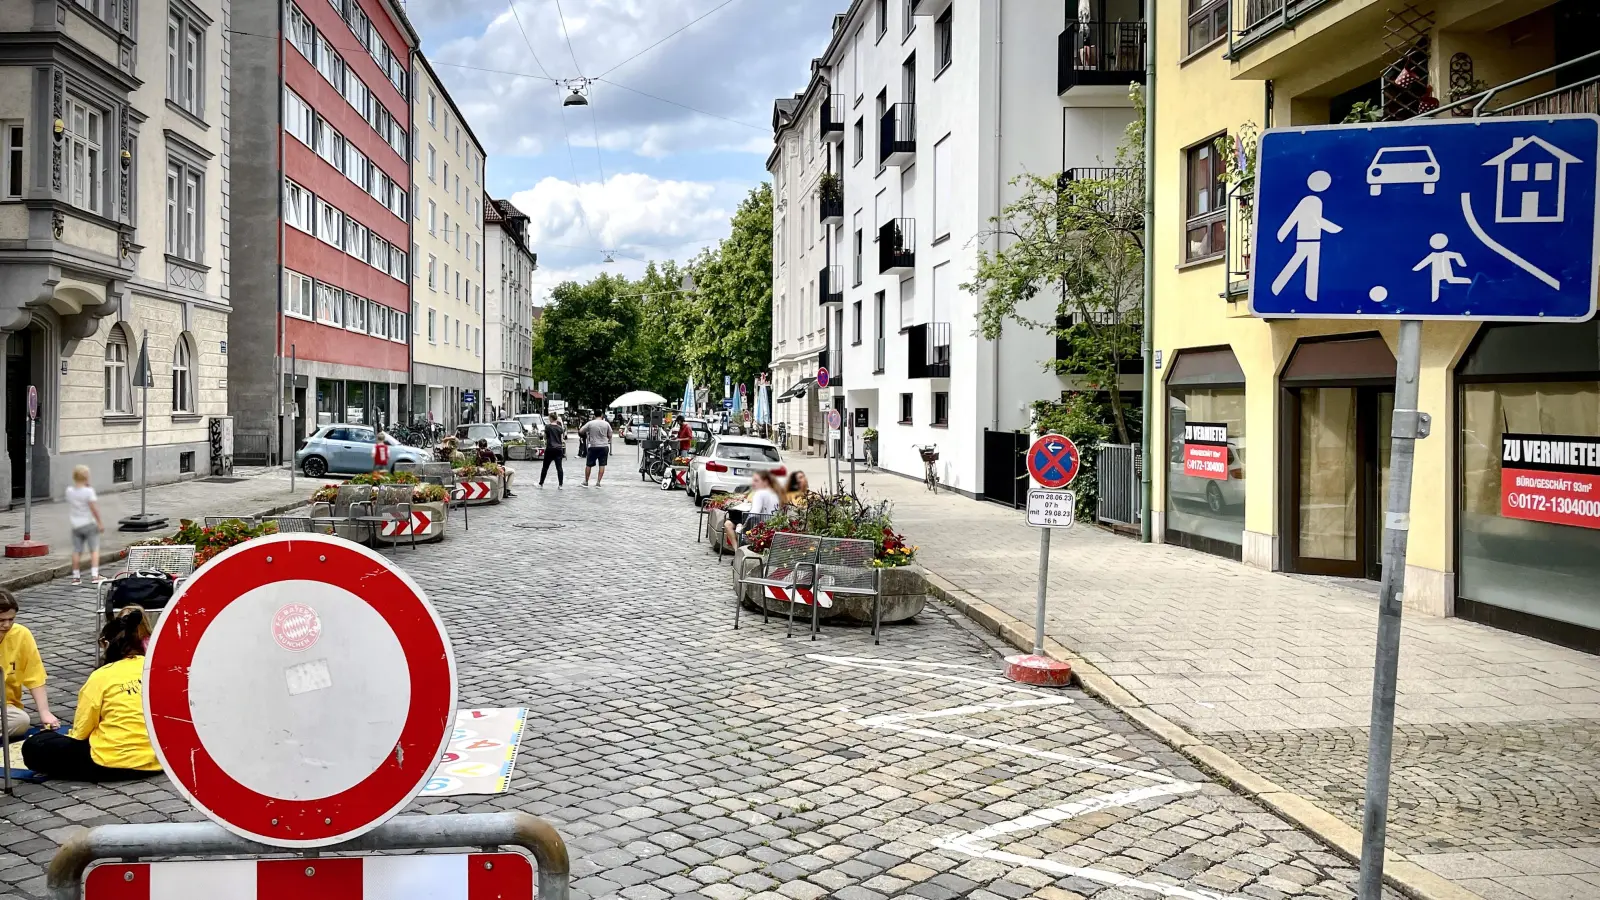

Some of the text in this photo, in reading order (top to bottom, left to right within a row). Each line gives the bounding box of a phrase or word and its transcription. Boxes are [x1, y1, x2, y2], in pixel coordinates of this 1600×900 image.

[1185, 425, 1227, 442] ZU VERMIETEN
[1503, 439, 1521, 461] ZU
[1516, 476, 1572, 491] BÜRO/GESCHÄFT
[1046, 493, 1072, 502] 28.06.23
[1519, 494, 1600, 518] 0172-1304000
